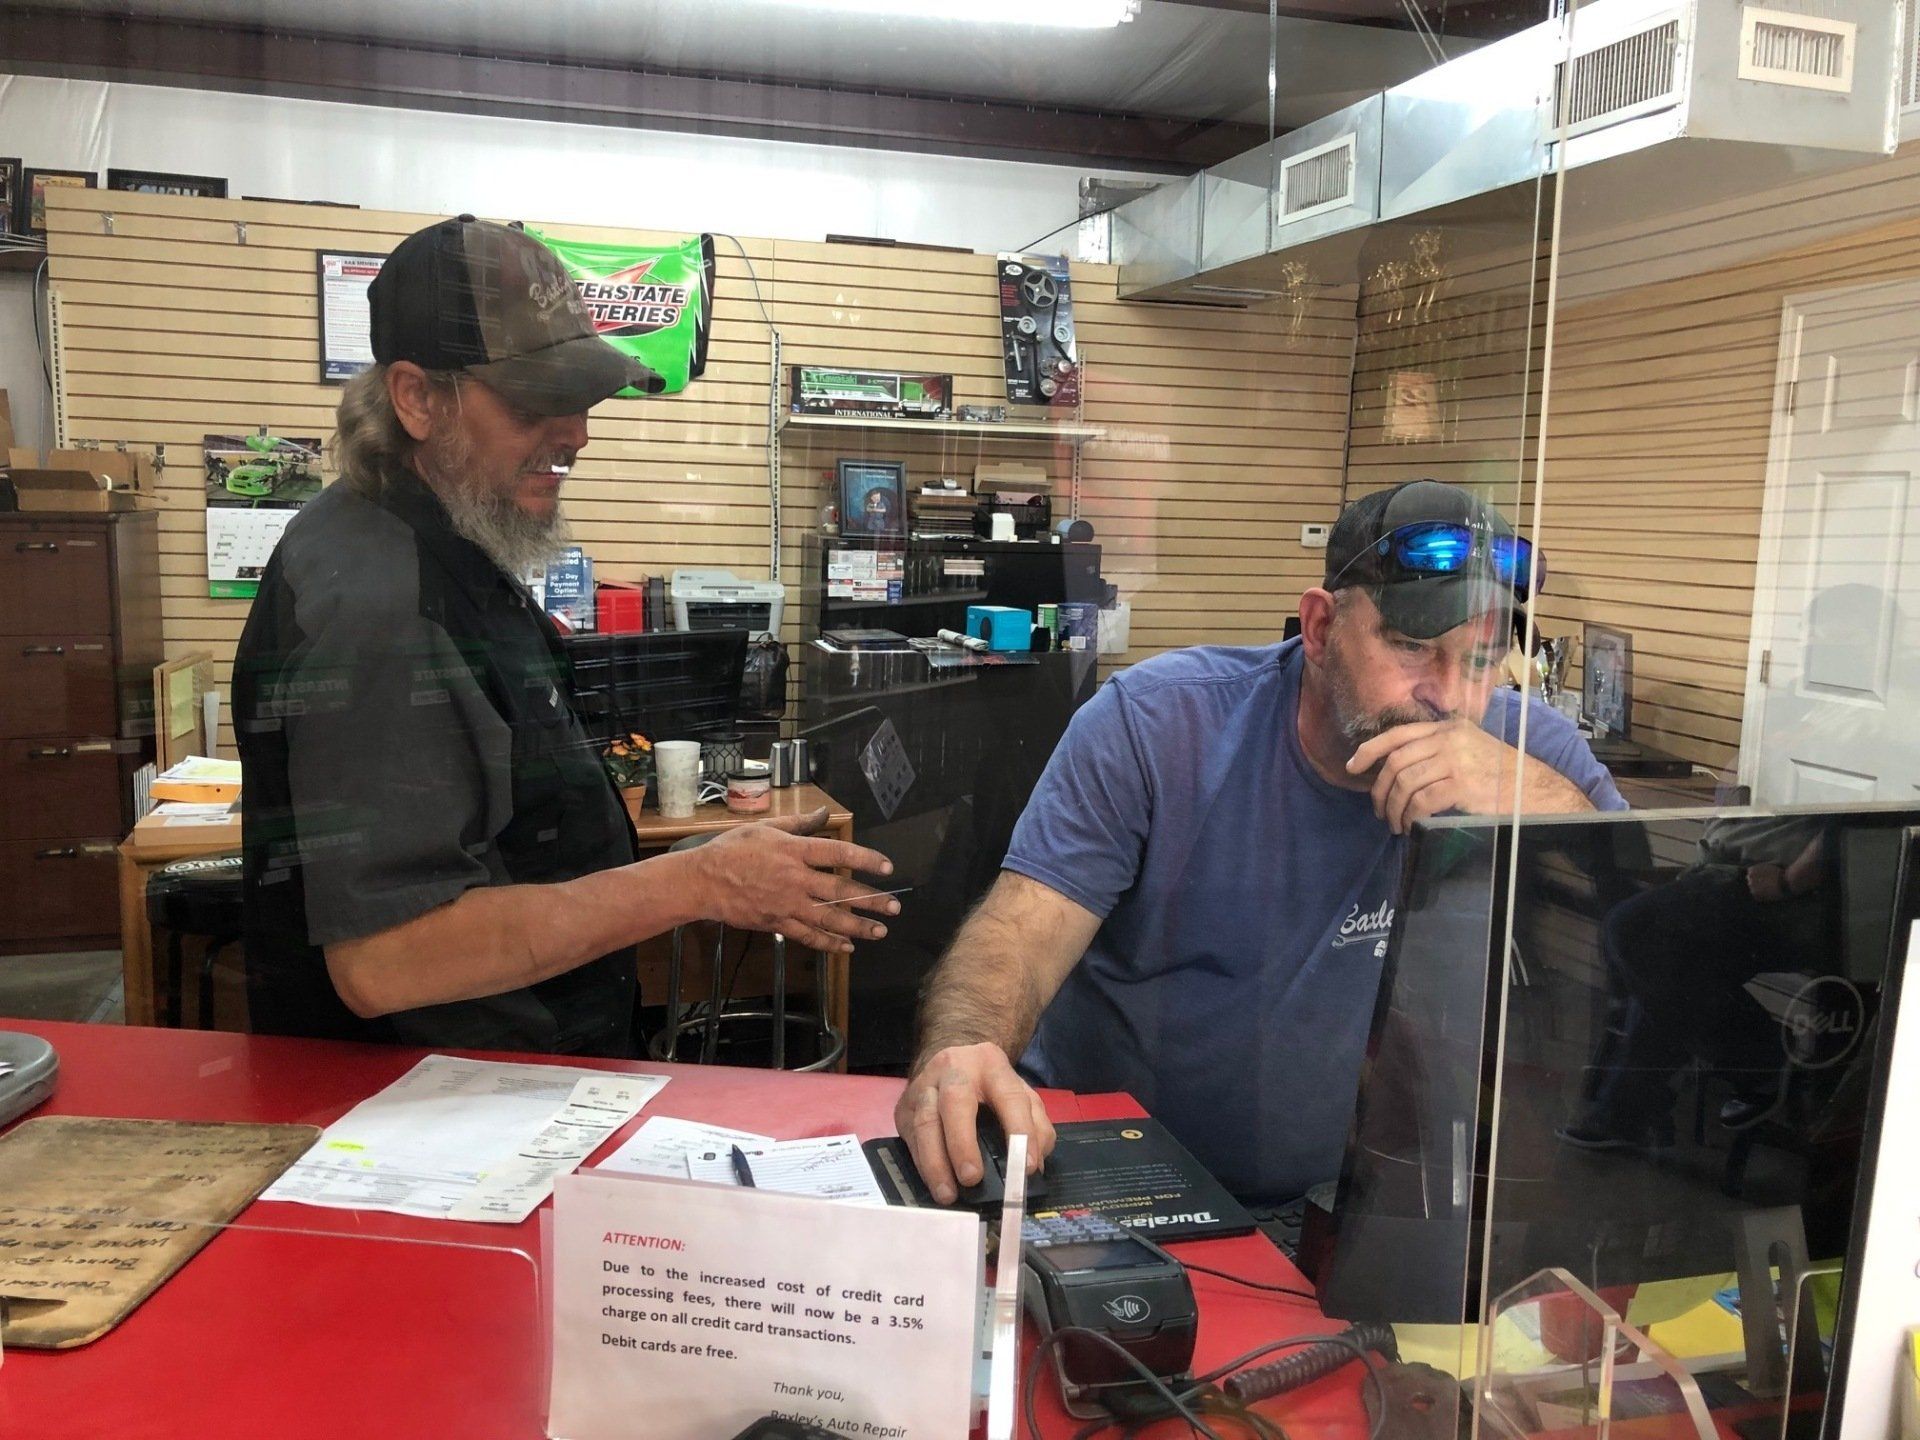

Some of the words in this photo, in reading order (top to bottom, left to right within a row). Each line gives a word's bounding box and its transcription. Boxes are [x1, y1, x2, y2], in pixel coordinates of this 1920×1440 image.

[574, 281, 687, 304] TERSTATE
[586, 304, 676, 323] TERIES
[835, 409, 891, 418] INTERNATIONAL
[1340, 899, 1395, 934] Baxle
[1120, 1211, 1220, 1228] Duralas
[602, 1231, 686, 1252] ATTENTION:
[602, 1260, 630, 1274] Due
[641, 1264, 655, 1277] to
[666, 1266, 688, 1281] the
[700, 1271, 765, 1290] increased
[777, 1280, 805, 1294] cost
[816, 1283, 831, 1297] of
[841, 1287, 882, 1304] credit
[893, 1292, 925, 1308] card
[602, 1284, 674, 1304] processing
[683, 1289, 715, 1307] fees,
[725, 1295, 761, 1311] there
[771, 1299, 795, 1316] will
[805, 1306, 835, 1320] now
[844, 1308, 861, 1323] be
[871, 1315, 879, 1326] a
[889, 1314, 924, 1330] 3.5%
[602, 1305, 646, 1323] charge
[650, 1311, 668, 1323] on
[671, 1309, 688, 1325] all
[691, 1313, 731, 1331] credit
[734, 1318, 764, 1334] card
[767, 1324, 856, 1345] transactions.
[602, 1333, 637, 1350] Debit
[640, 1337, 677, 1354] cards
[680, 1344, 702, 1357] are
[706, 1343, 738, 1360] free.
[773, 1382, 813, 1397] Thank
[816, 1389, 845, 1402] you,
[827, 1417, 859, 1432] Auto
[862, 1422, 908, 1439] Repair
